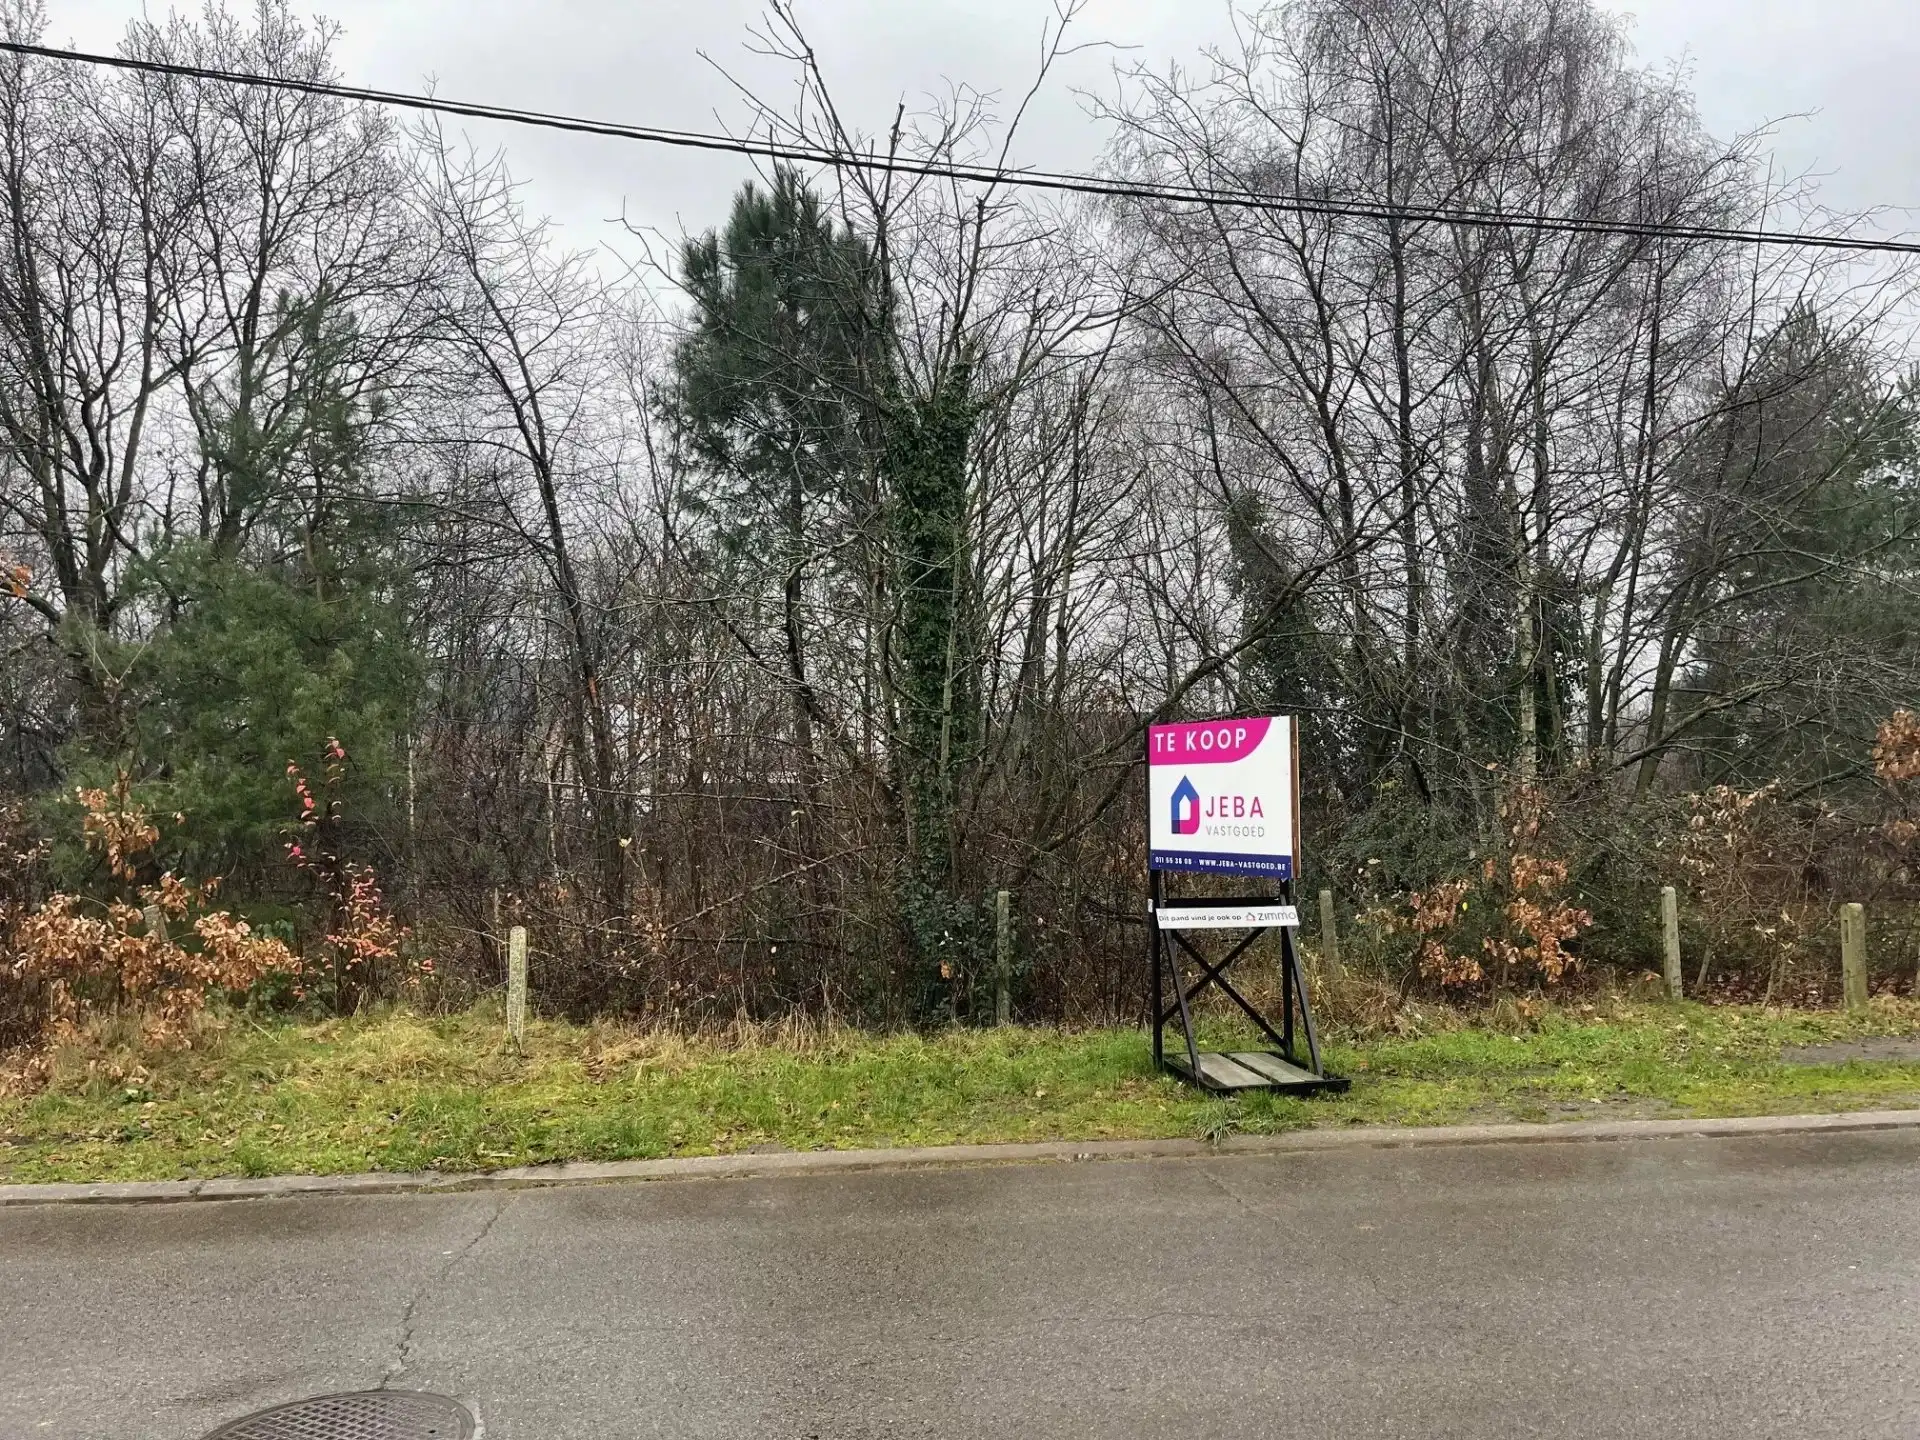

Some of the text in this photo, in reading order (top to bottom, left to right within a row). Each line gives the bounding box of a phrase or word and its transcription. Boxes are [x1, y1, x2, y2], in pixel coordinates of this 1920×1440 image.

[1155, 728, 1247, 752] TE KOOP
[1205, 796, 1264, 818] JEBA
[1205, 825, 1265, 838] VASTGOED
[1198, 859, 1286, 871] WWW.JEBA-VASTGOED.BE
[1207, 914, 1215, 922] je
